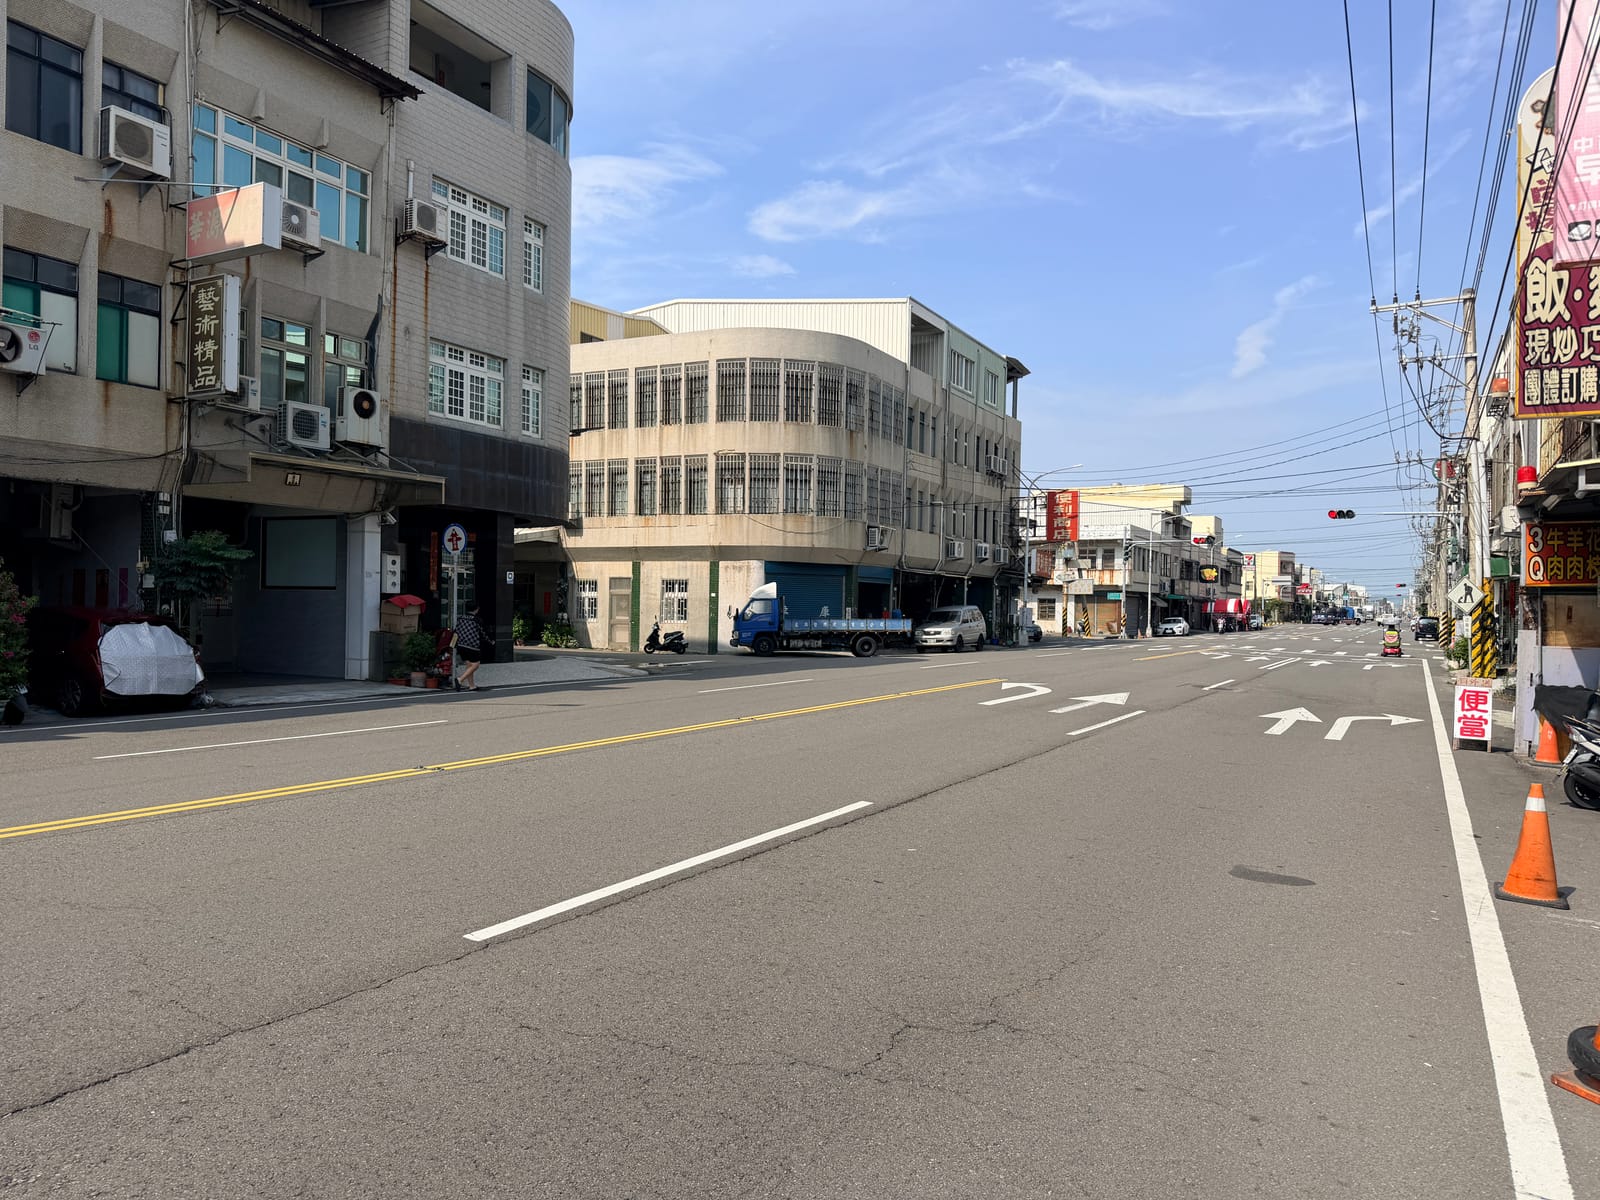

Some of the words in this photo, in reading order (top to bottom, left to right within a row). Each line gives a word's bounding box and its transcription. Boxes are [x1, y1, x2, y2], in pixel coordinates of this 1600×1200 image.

[194, 286, 220, 388] 藝術精品
[1053, 492, 1073, 541] 便利商店
[1458, 688, 1489, 738] 便當
